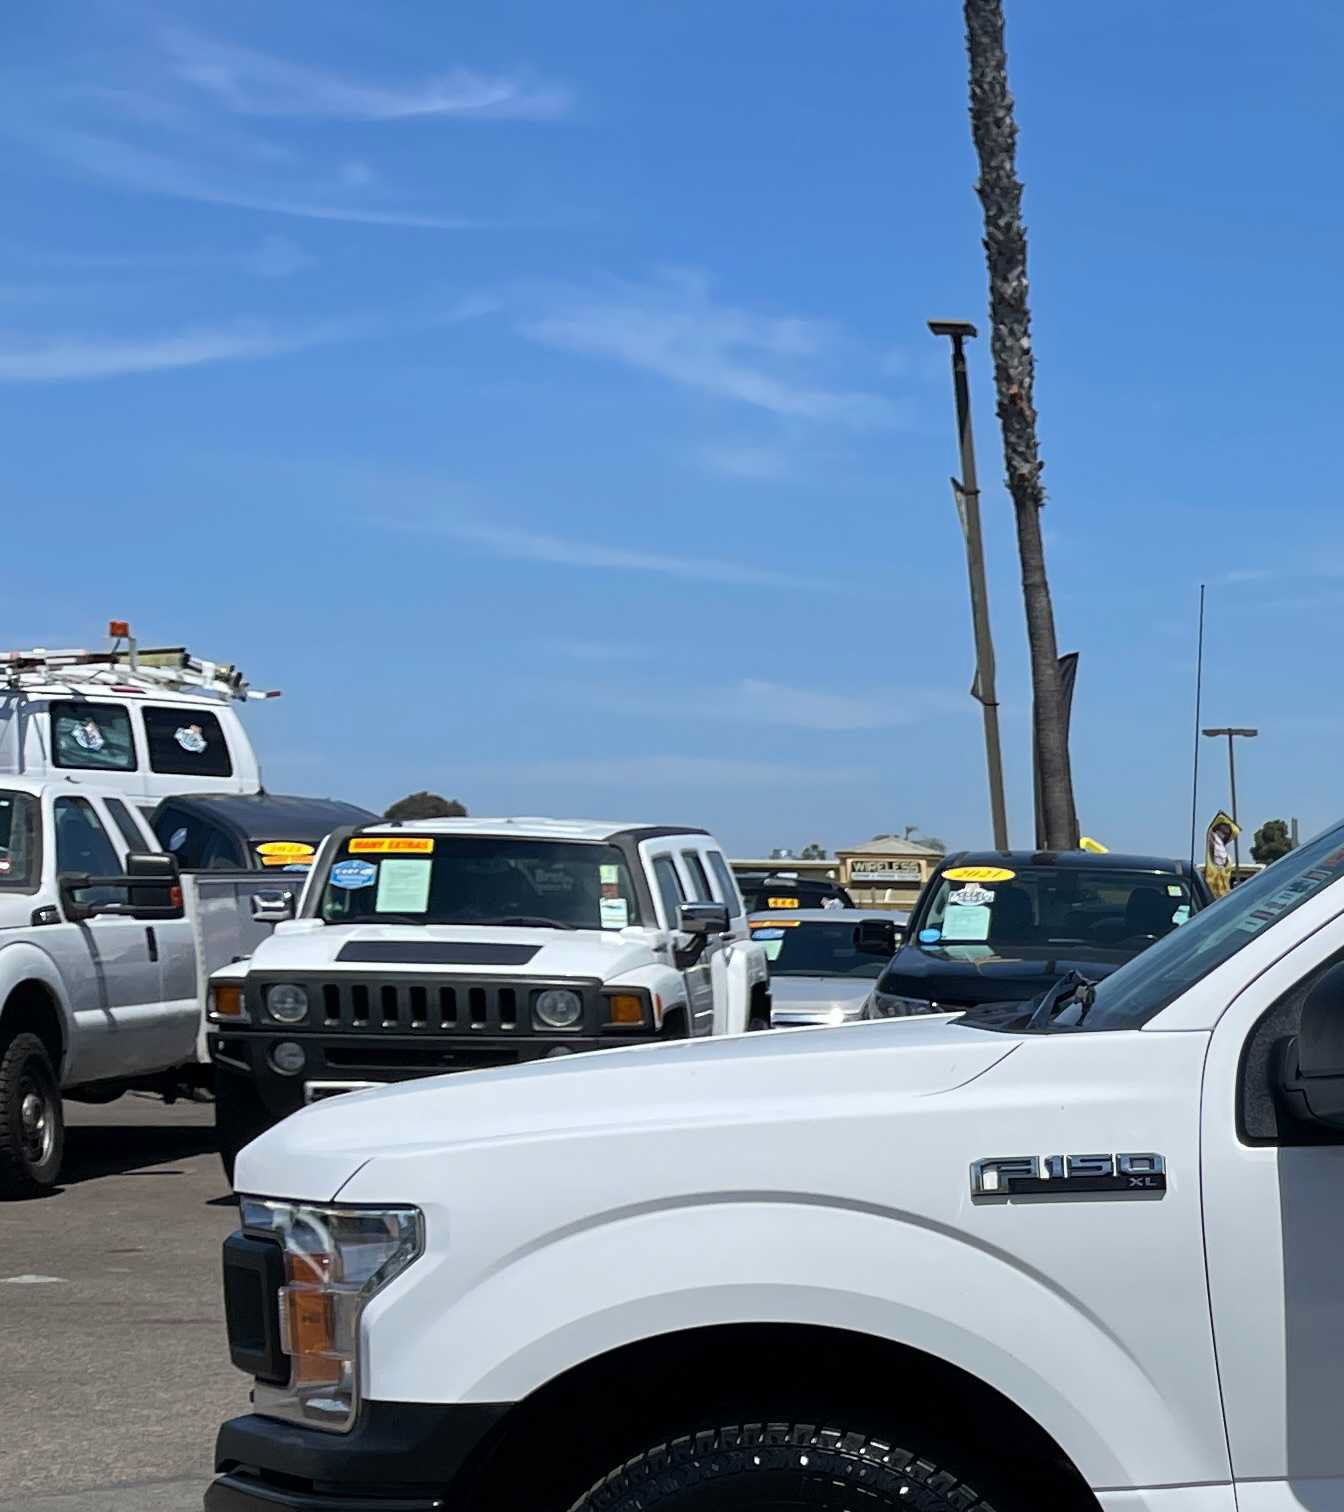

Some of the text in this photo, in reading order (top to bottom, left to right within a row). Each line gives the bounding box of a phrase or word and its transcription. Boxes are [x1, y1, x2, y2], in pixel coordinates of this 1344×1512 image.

[852, 861, 920, 873] WIRELESS
[954, 870, 1004, 879] 2021
[1129, 1177, 1157, 1187] XL
